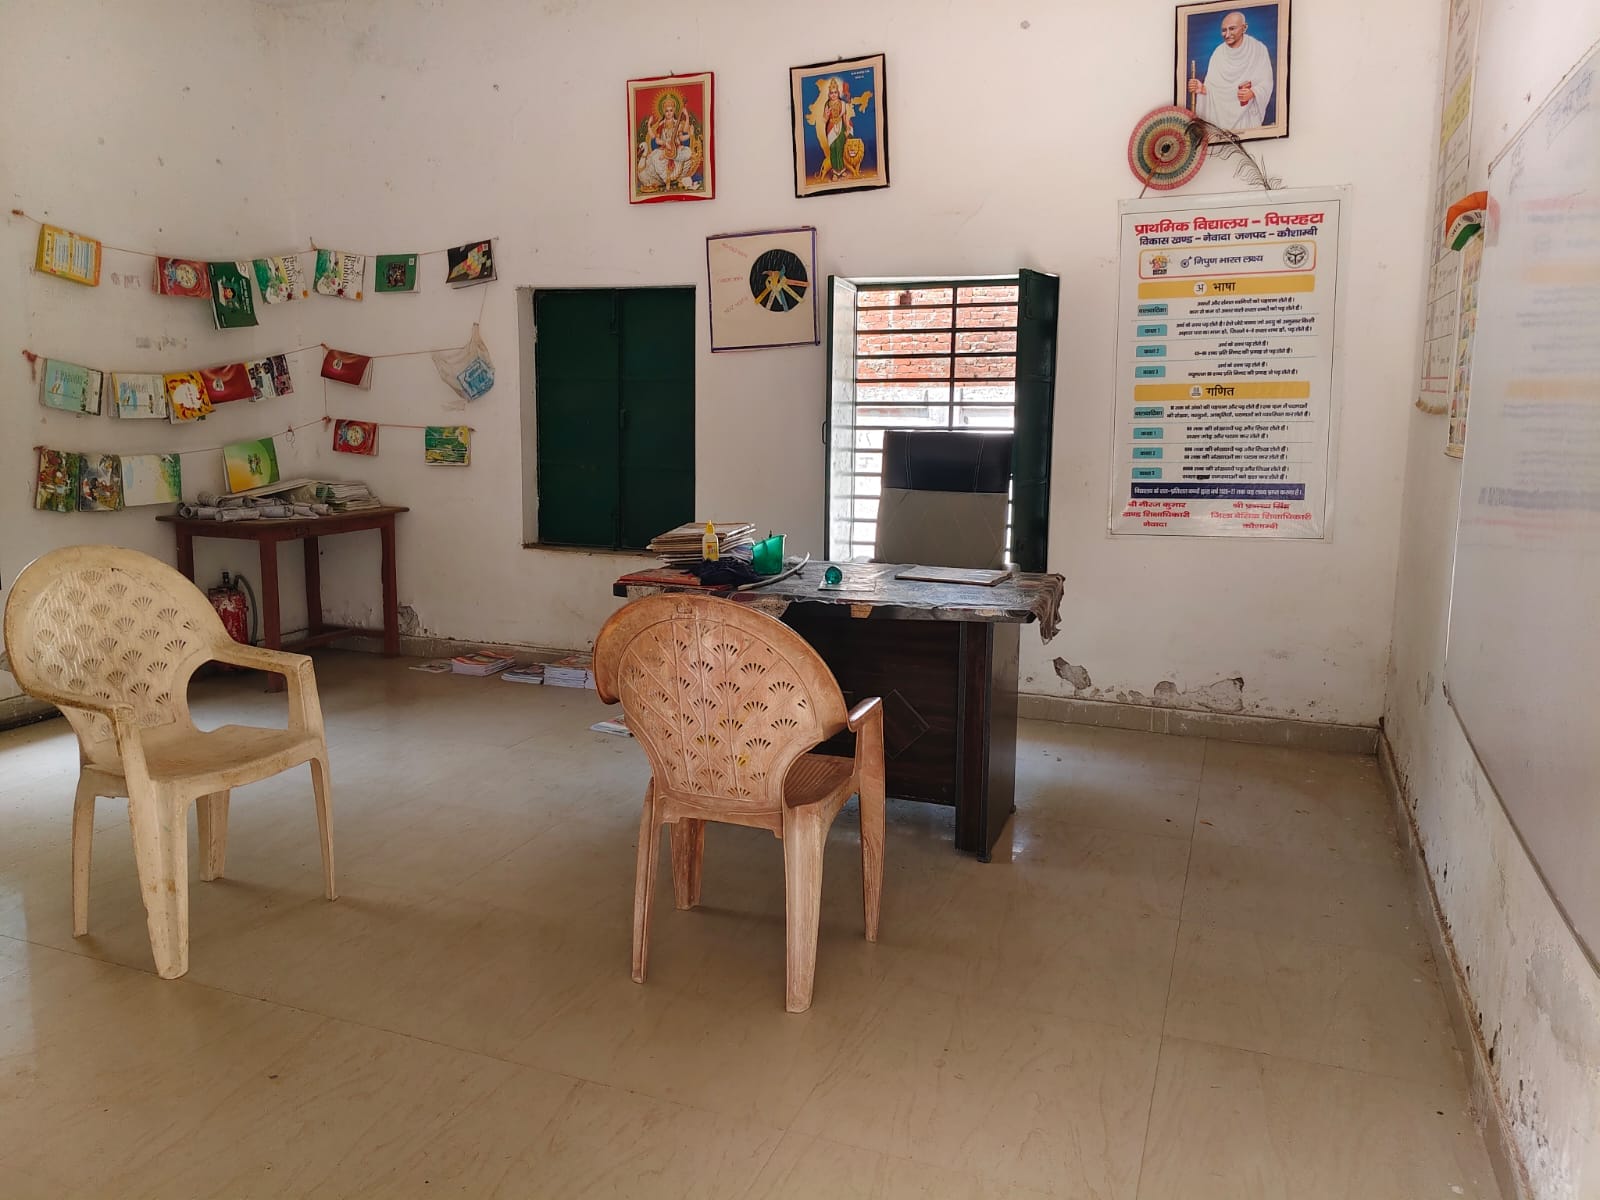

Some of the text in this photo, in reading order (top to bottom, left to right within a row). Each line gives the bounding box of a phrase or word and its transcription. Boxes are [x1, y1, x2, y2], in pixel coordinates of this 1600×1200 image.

[1134, 219, 1190, 236] प्राथमिक
[1193, 217, 1249, 231] विद्यालय
[1264, 212, 1325, 226] पिपरहटा
[1139, 236, 1169, 246] विकास
[1171, 235, 1194, 244] खण्ड
[1203, 232, 1230, 242] नेवादा
[1235, 231, 1266, 240] जनपद
[1277, 225, 1318, 238] कौशाम्बी
[1193, 256, 1217, 267] निपुण
[1219, 256, 1241, 264] भारत
[343, 255, 352, 289] Rabbits
[1213, 282, 1237, 292] भाषा
[1206, 385, 1235, 397] गणित
